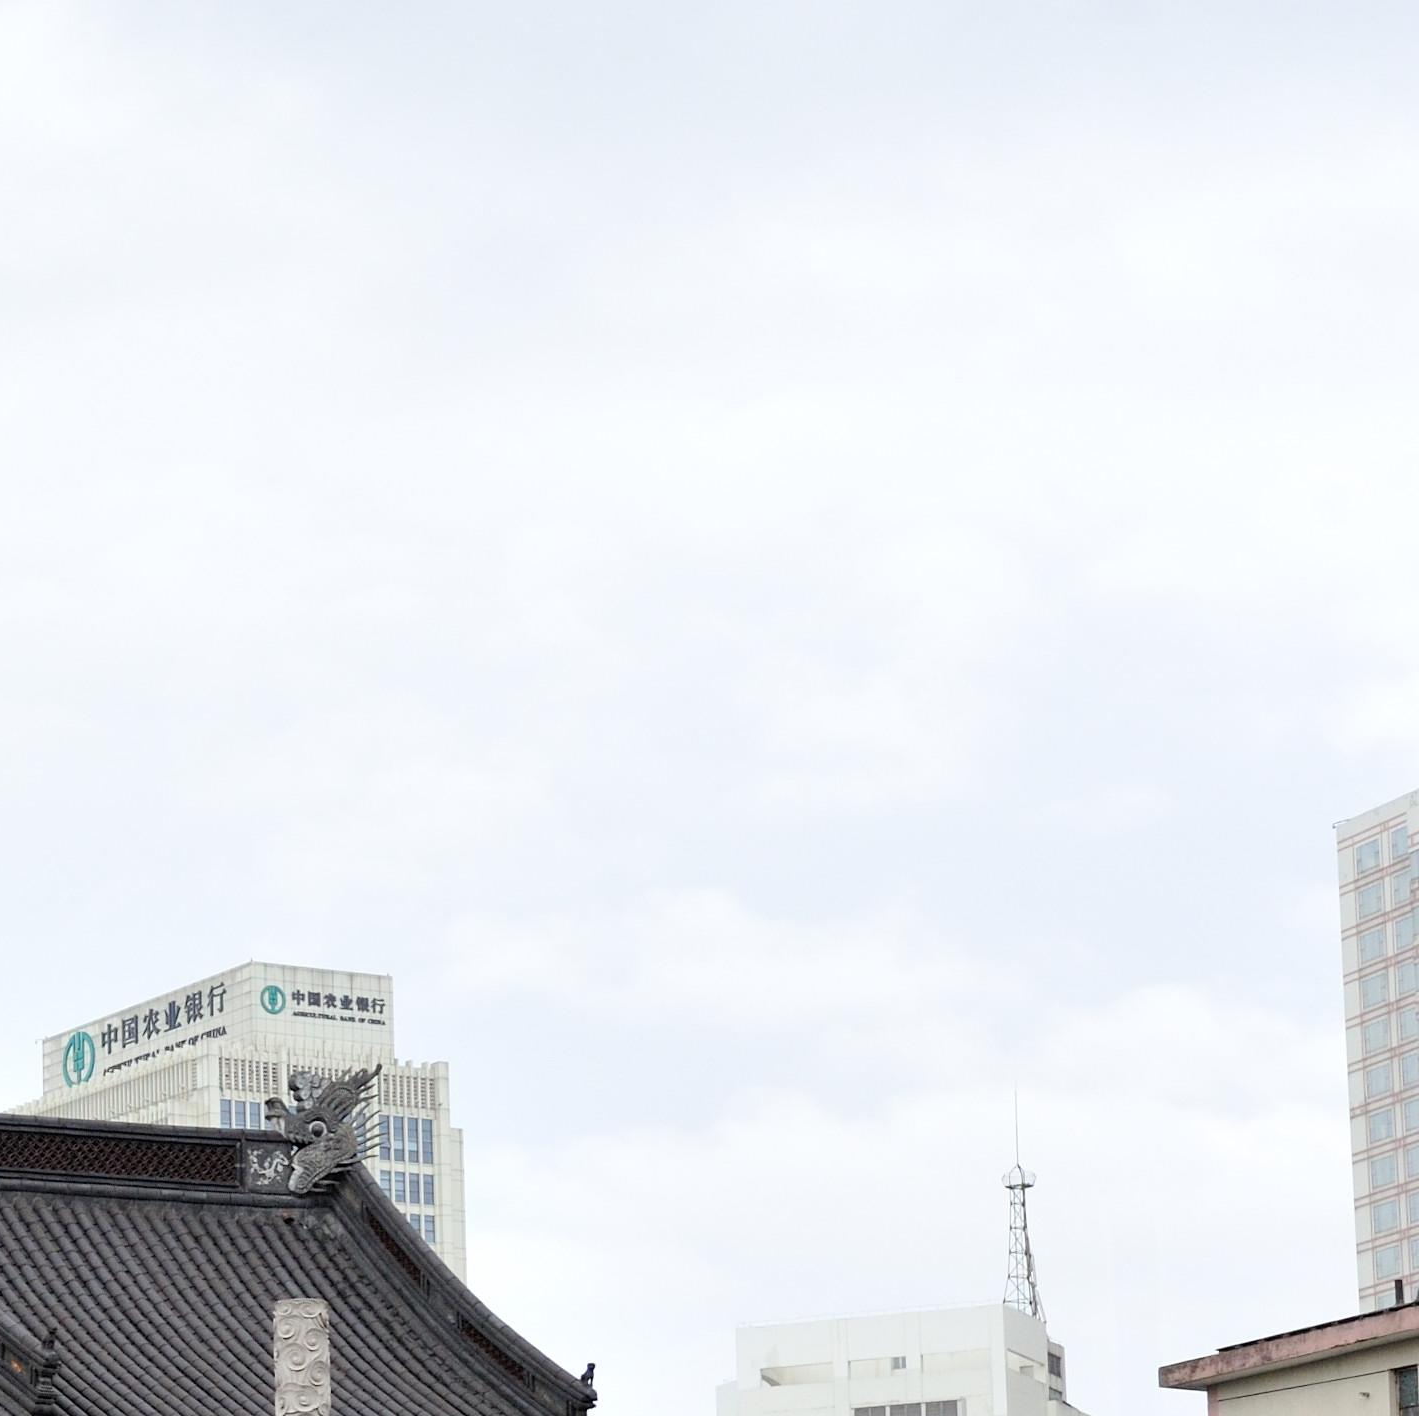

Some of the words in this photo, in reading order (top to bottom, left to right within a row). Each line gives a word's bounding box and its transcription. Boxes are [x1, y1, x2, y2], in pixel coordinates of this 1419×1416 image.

[101, 981, 228, 1056] 中国农业银行
[291, 989, 386, 1014] 中国农业银行
